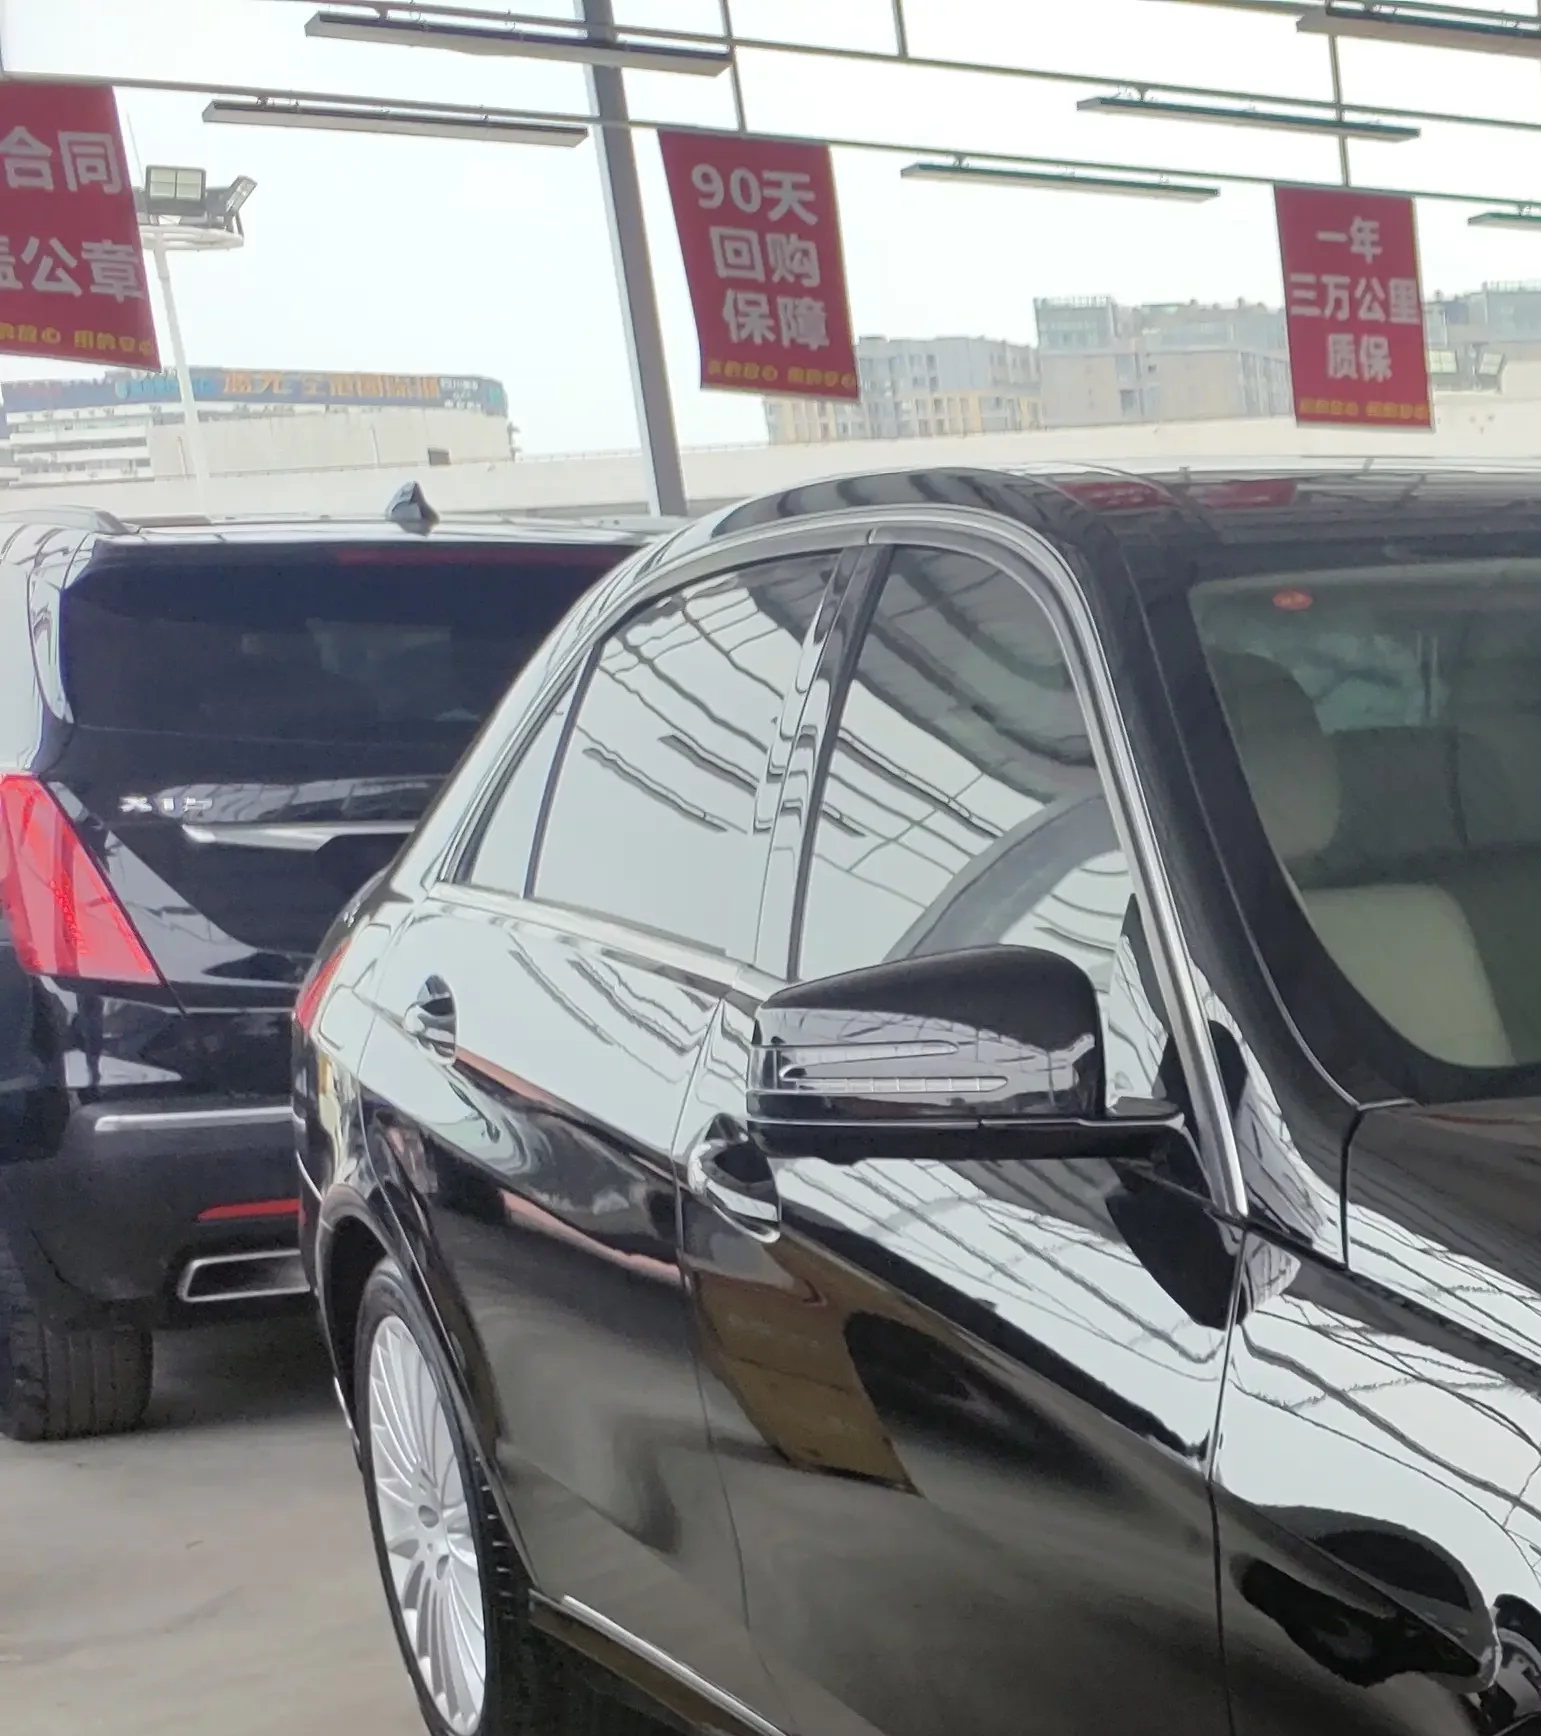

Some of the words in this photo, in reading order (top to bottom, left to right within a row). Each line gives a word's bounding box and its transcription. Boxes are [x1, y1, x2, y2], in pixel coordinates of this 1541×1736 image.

[0, 126, 122, 194] 合同
[691, 163, 819, 226] 90天
[709, 225, 821, 288] 回购
[1315, 215, 1383, 265] 一年
[723, 288, 831, 351] 保障
[1289, 273, 1421, 325] 三万公里
[1327, 333, 1394, 383] 质保
